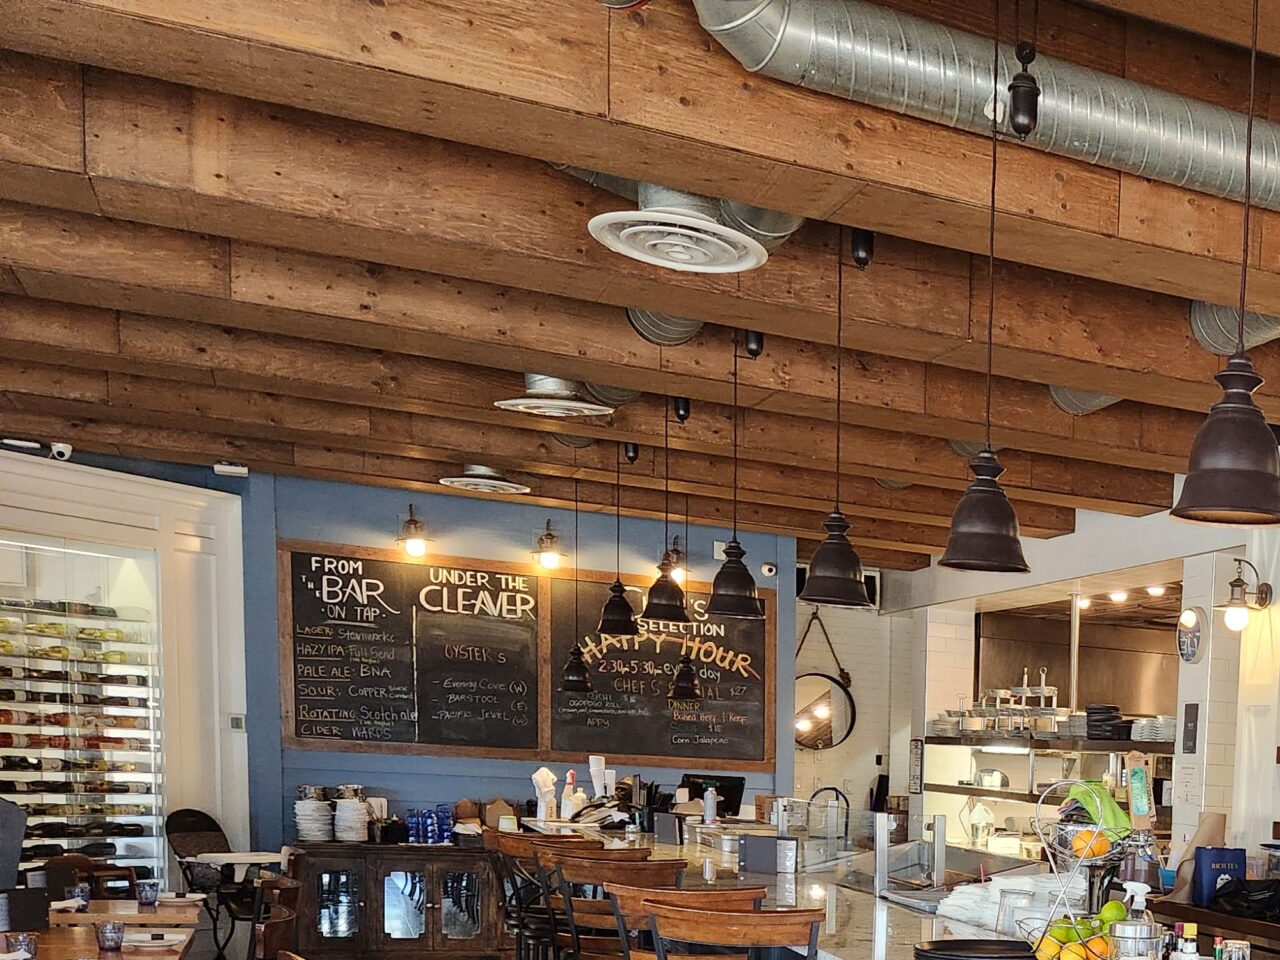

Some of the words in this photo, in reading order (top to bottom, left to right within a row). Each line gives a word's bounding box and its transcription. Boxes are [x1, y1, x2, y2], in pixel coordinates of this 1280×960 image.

[311, 556, 363, 576] FROM
[429, 567, 495, 590] UNDER
[495, 574, 529, 591] THE
[322, 575, 400, 614] BAR
[419, 585, 536, 620] CLEAVER
[327, 604, 347, 619] ON
[354, 606, 380, 622] TAP
[637, 617, 725, 637] SELECTION
[296, 643, 326, 656] HAZY
[577, 631, 666, 664] HAPPY
[680, 634, 752, 678] HOUR
[297, 664, 328, 677] PALE
[360, 663, 392, 678] BNA
[698, 664, 721, 684] day
[297, 703, 356, 719] ROTATING
[360, 705, 398, 720] Scotch
[667, 698, 701, 713] DINNER
[672, 734, 690, 744] Corn
